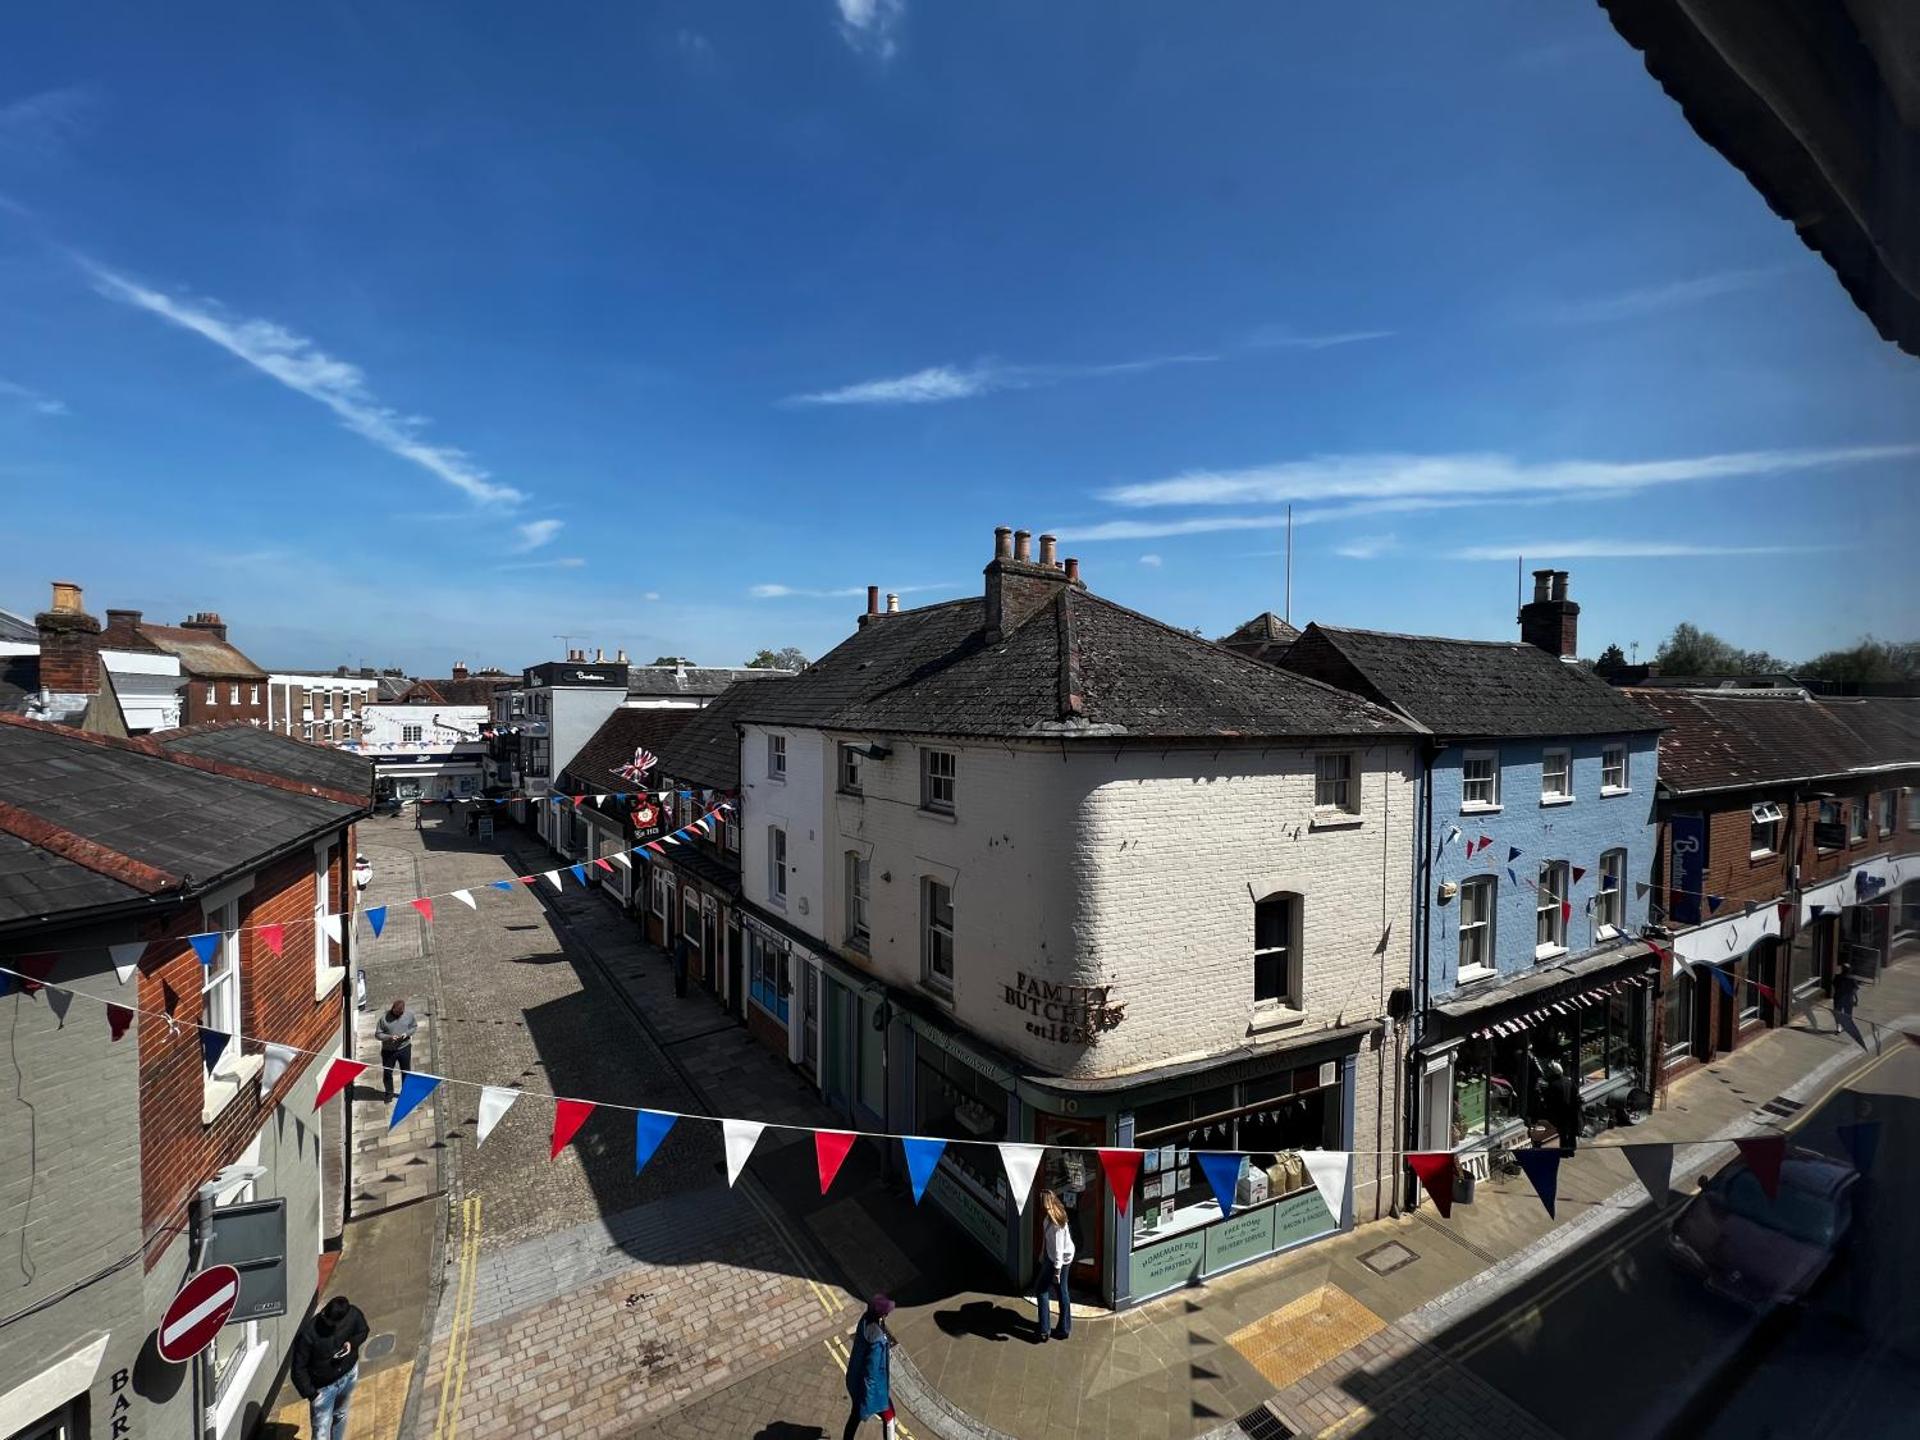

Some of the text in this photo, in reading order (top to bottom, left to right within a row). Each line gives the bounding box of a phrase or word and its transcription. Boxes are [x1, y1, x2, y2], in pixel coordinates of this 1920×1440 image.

[1060, 1098, 1078, 1113] 10
[1142, 1242, 1183, 1268] HOMEMADE
[110, 1368, 131, 1440] BAR
